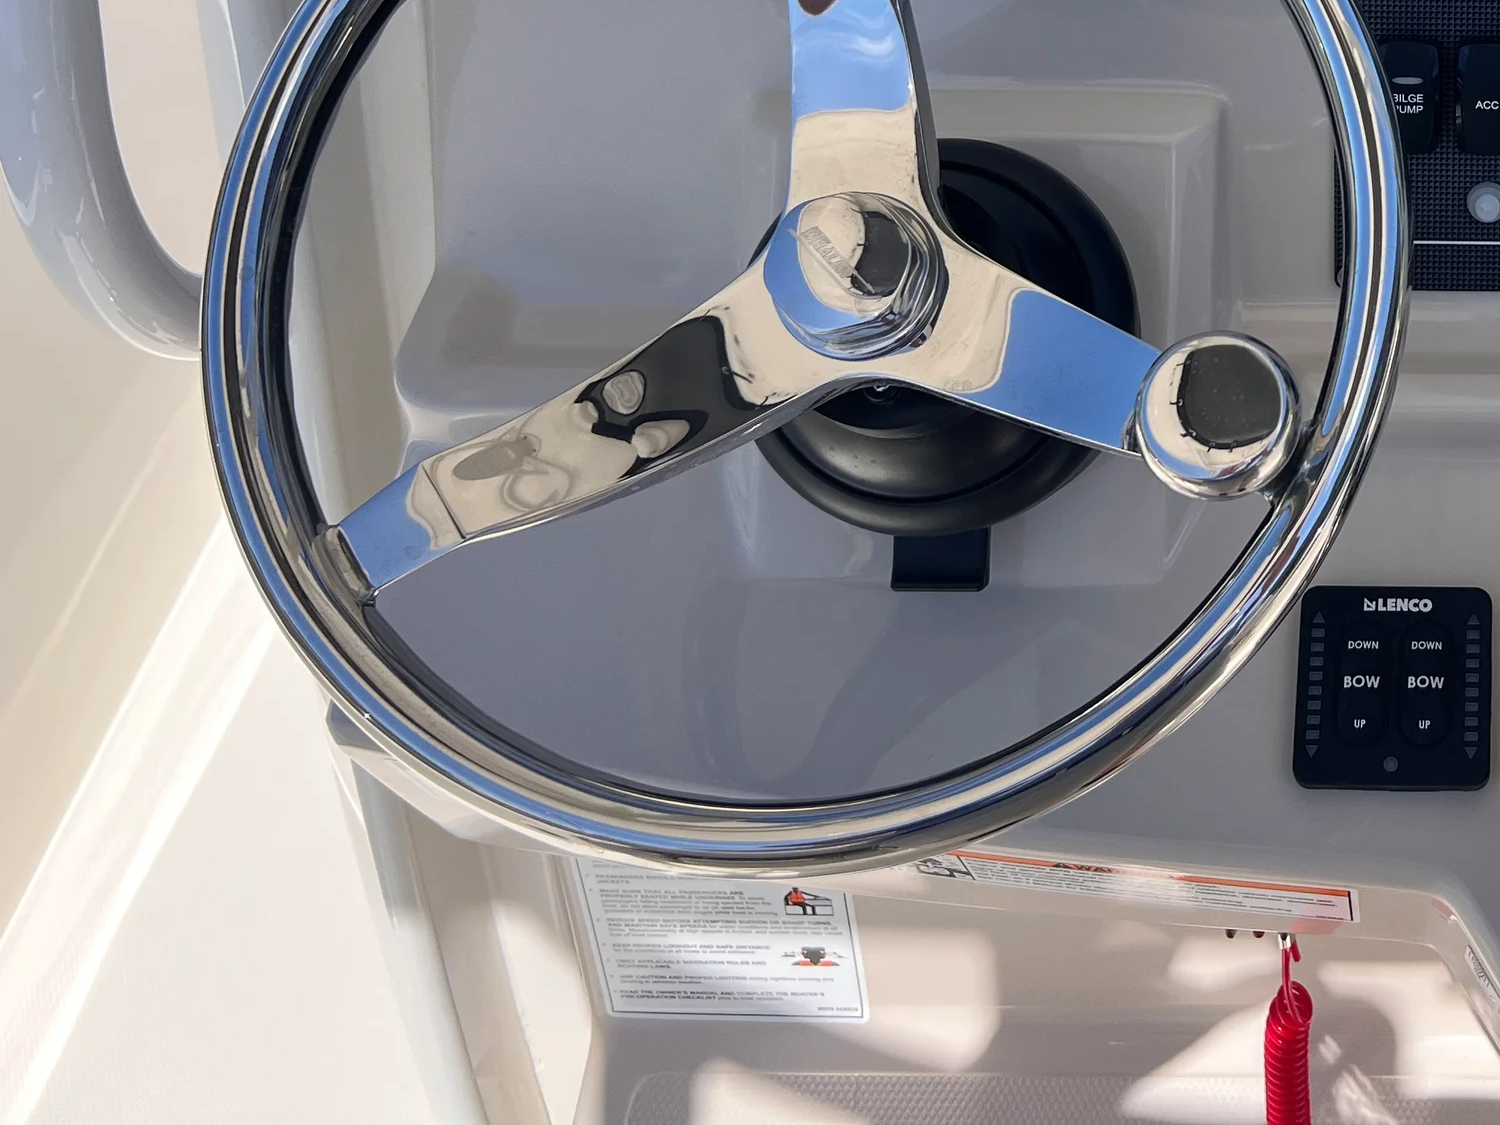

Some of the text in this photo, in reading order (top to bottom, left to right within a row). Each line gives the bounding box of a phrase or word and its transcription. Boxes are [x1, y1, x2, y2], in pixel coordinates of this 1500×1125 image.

[1393, 93, 1424, 103] BILGE
[1475, 100, 1499, 110] ACC
[1377, 598, 1433, 612] LENCO
[1348, 640, 1379, 650] DOWN
[1411, 641, 1442, 650] DOWN
[1343, 675, 1380, 689] BOW
[1407, 675, 1445, 689] BOW
[1354, 719, 1366, 729] UP
[1418, 720, 1431, 729] UP
